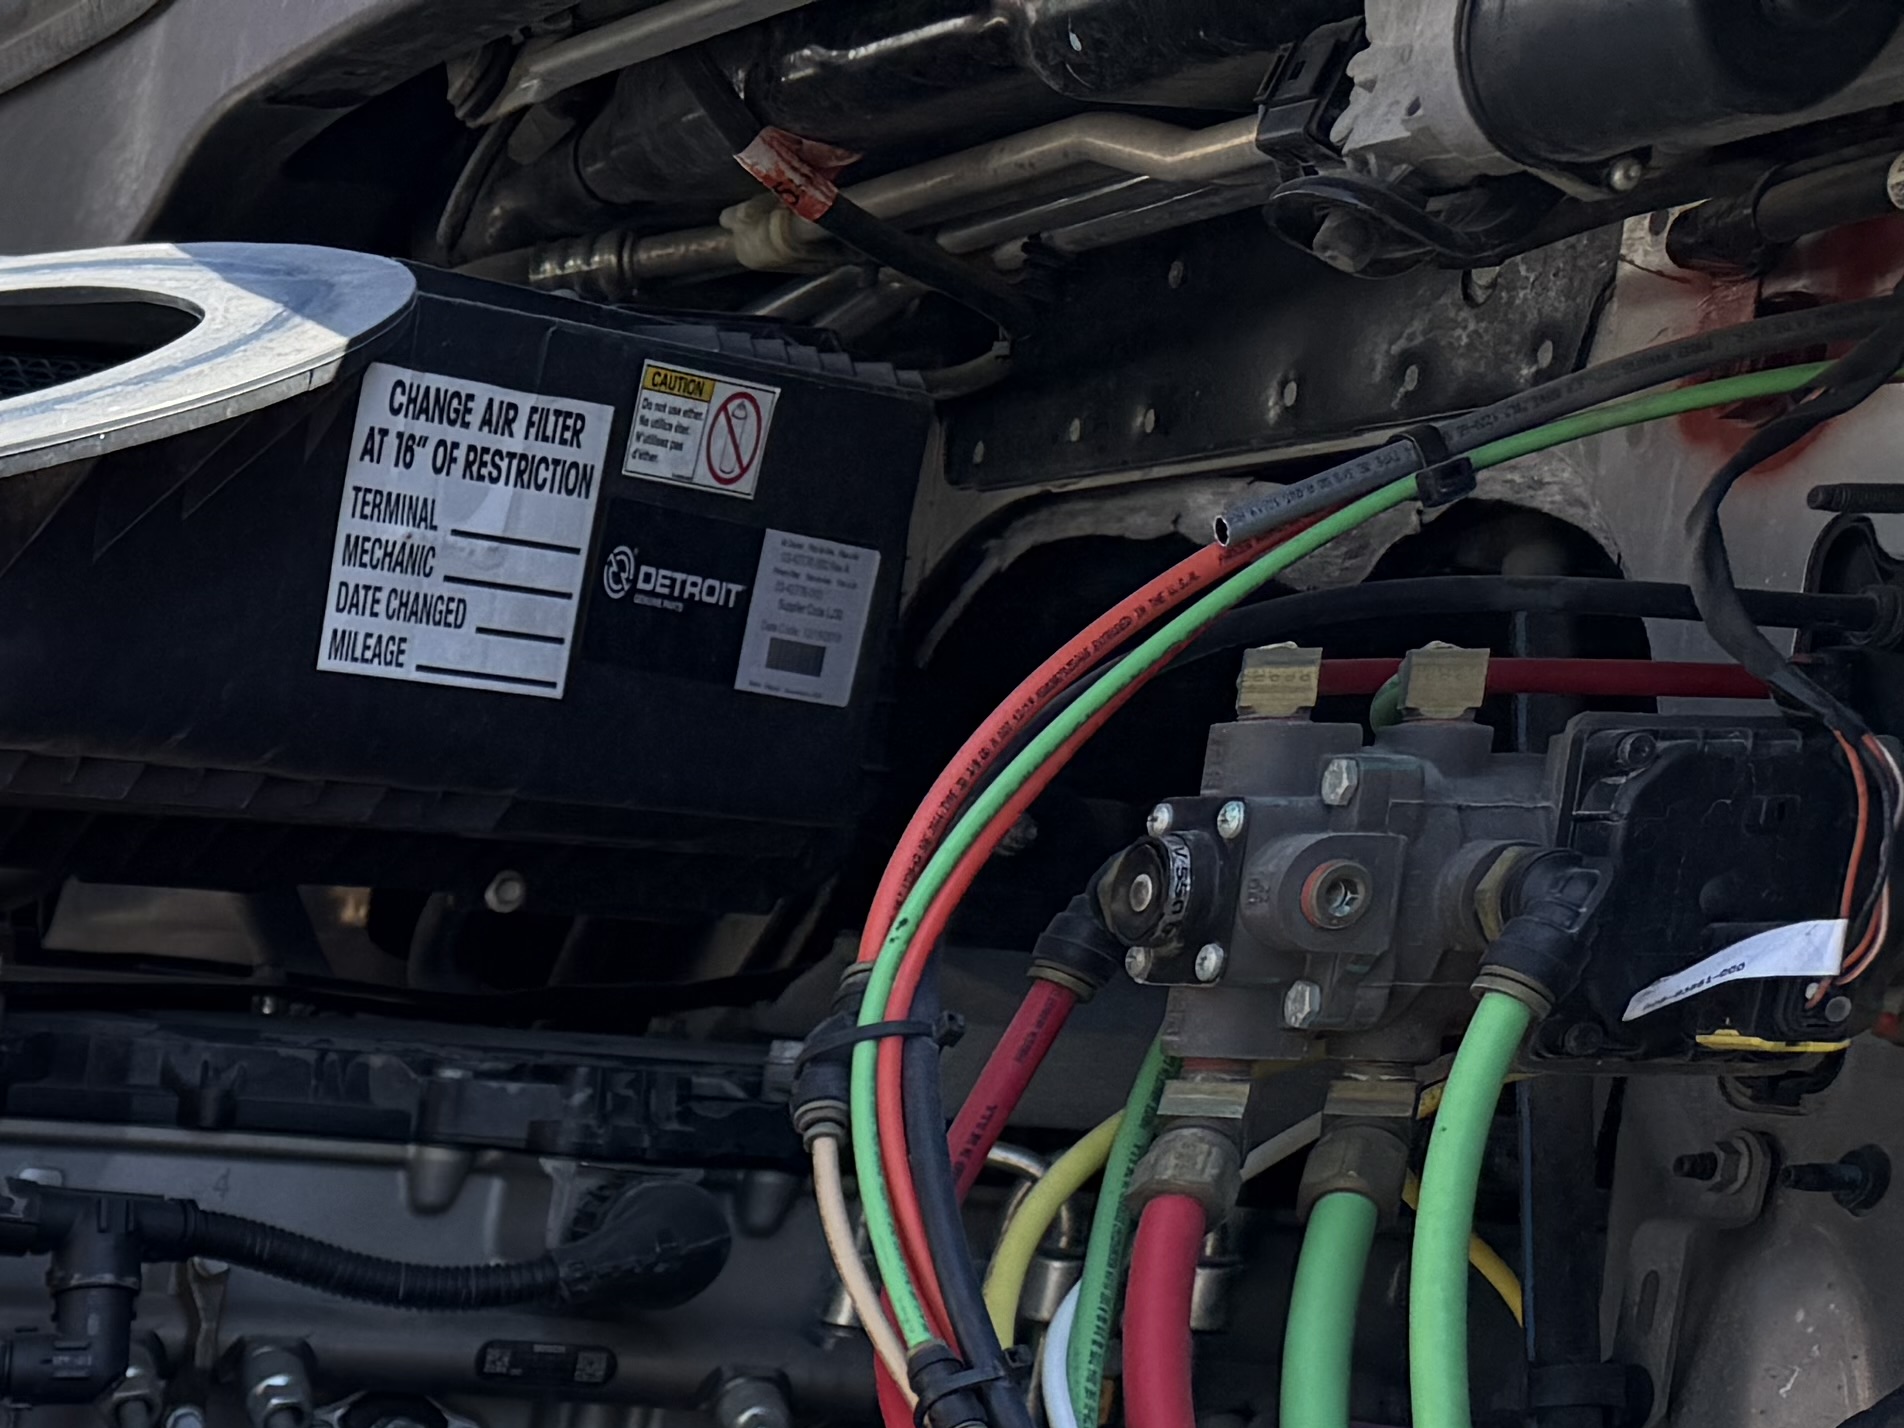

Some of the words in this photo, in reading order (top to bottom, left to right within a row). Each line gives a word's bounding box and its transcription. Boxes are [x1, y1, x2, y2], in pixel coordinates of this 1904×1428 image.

[652, 371, 705, 397] CAUTION
[390, 379, 475, 432] CHANGE
[478, 402, 516, 441] AIR
[526, 405, 585, 449] FILTER
[655, 401, 667, 413] not
[668, 405, 681, 416] use
[361, 426, 390, 465] AT
[393, 430, 427, 471] 16"
[431, 442, 459, 479] OF
[462, 446, 594, 500] RESTRICTION
[352, 486, 438, 531] TERMINAL
[342, 534, 435, 578] MECHANIC
[336, 581, 383, 622] DATE
[386, 589, 467, 631] CHANGED
[636, 565, 747, 608] DETROIT
[328, 628, 407, 669] MILEAGE
